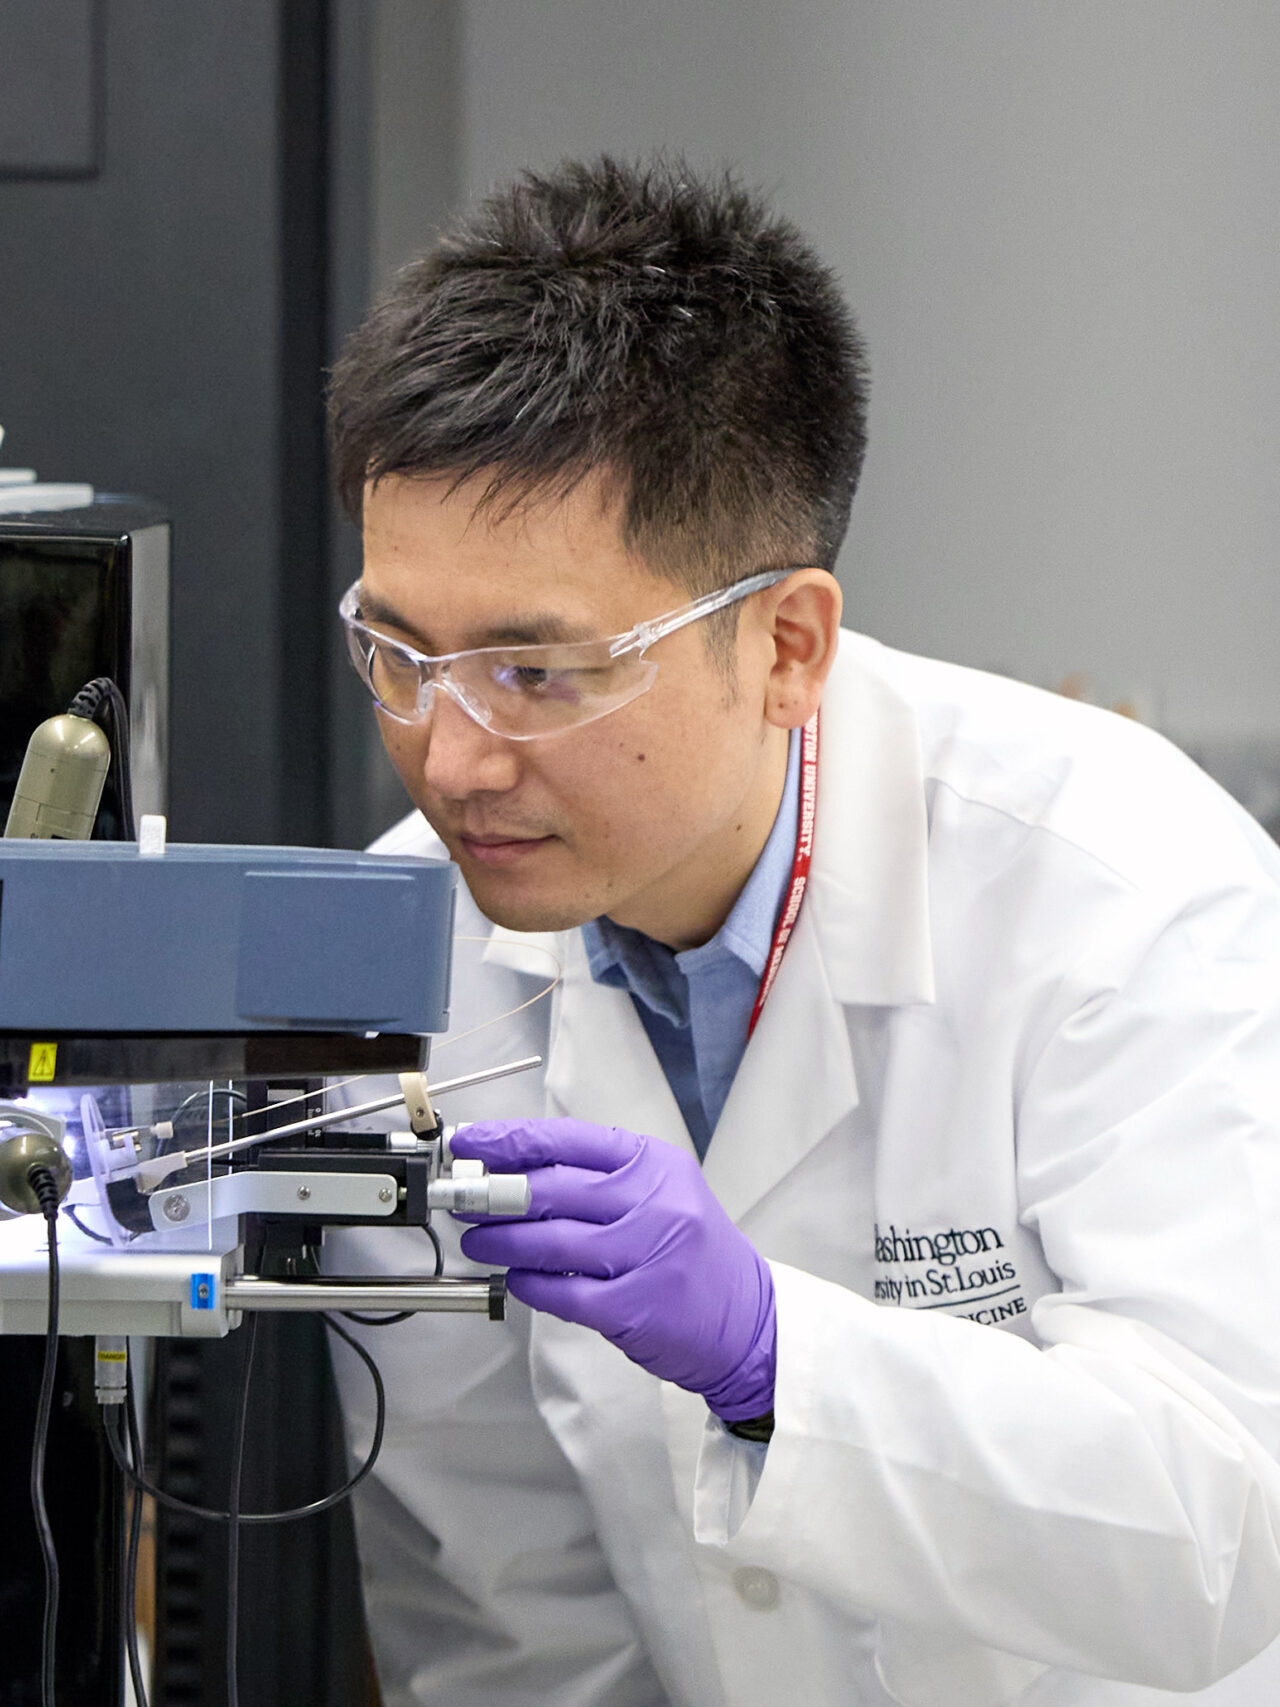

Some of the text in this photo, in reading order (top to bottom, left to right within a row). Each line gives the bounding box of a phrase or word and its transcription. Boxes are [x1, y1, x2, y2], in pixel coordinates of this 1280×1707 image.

[804, 711, 818, 762] NGTON
[874, 1223, 1005, 1266] ashington
[874, 1275, 903, 1306] rsity
[905, 1275, 927, 1298] in
